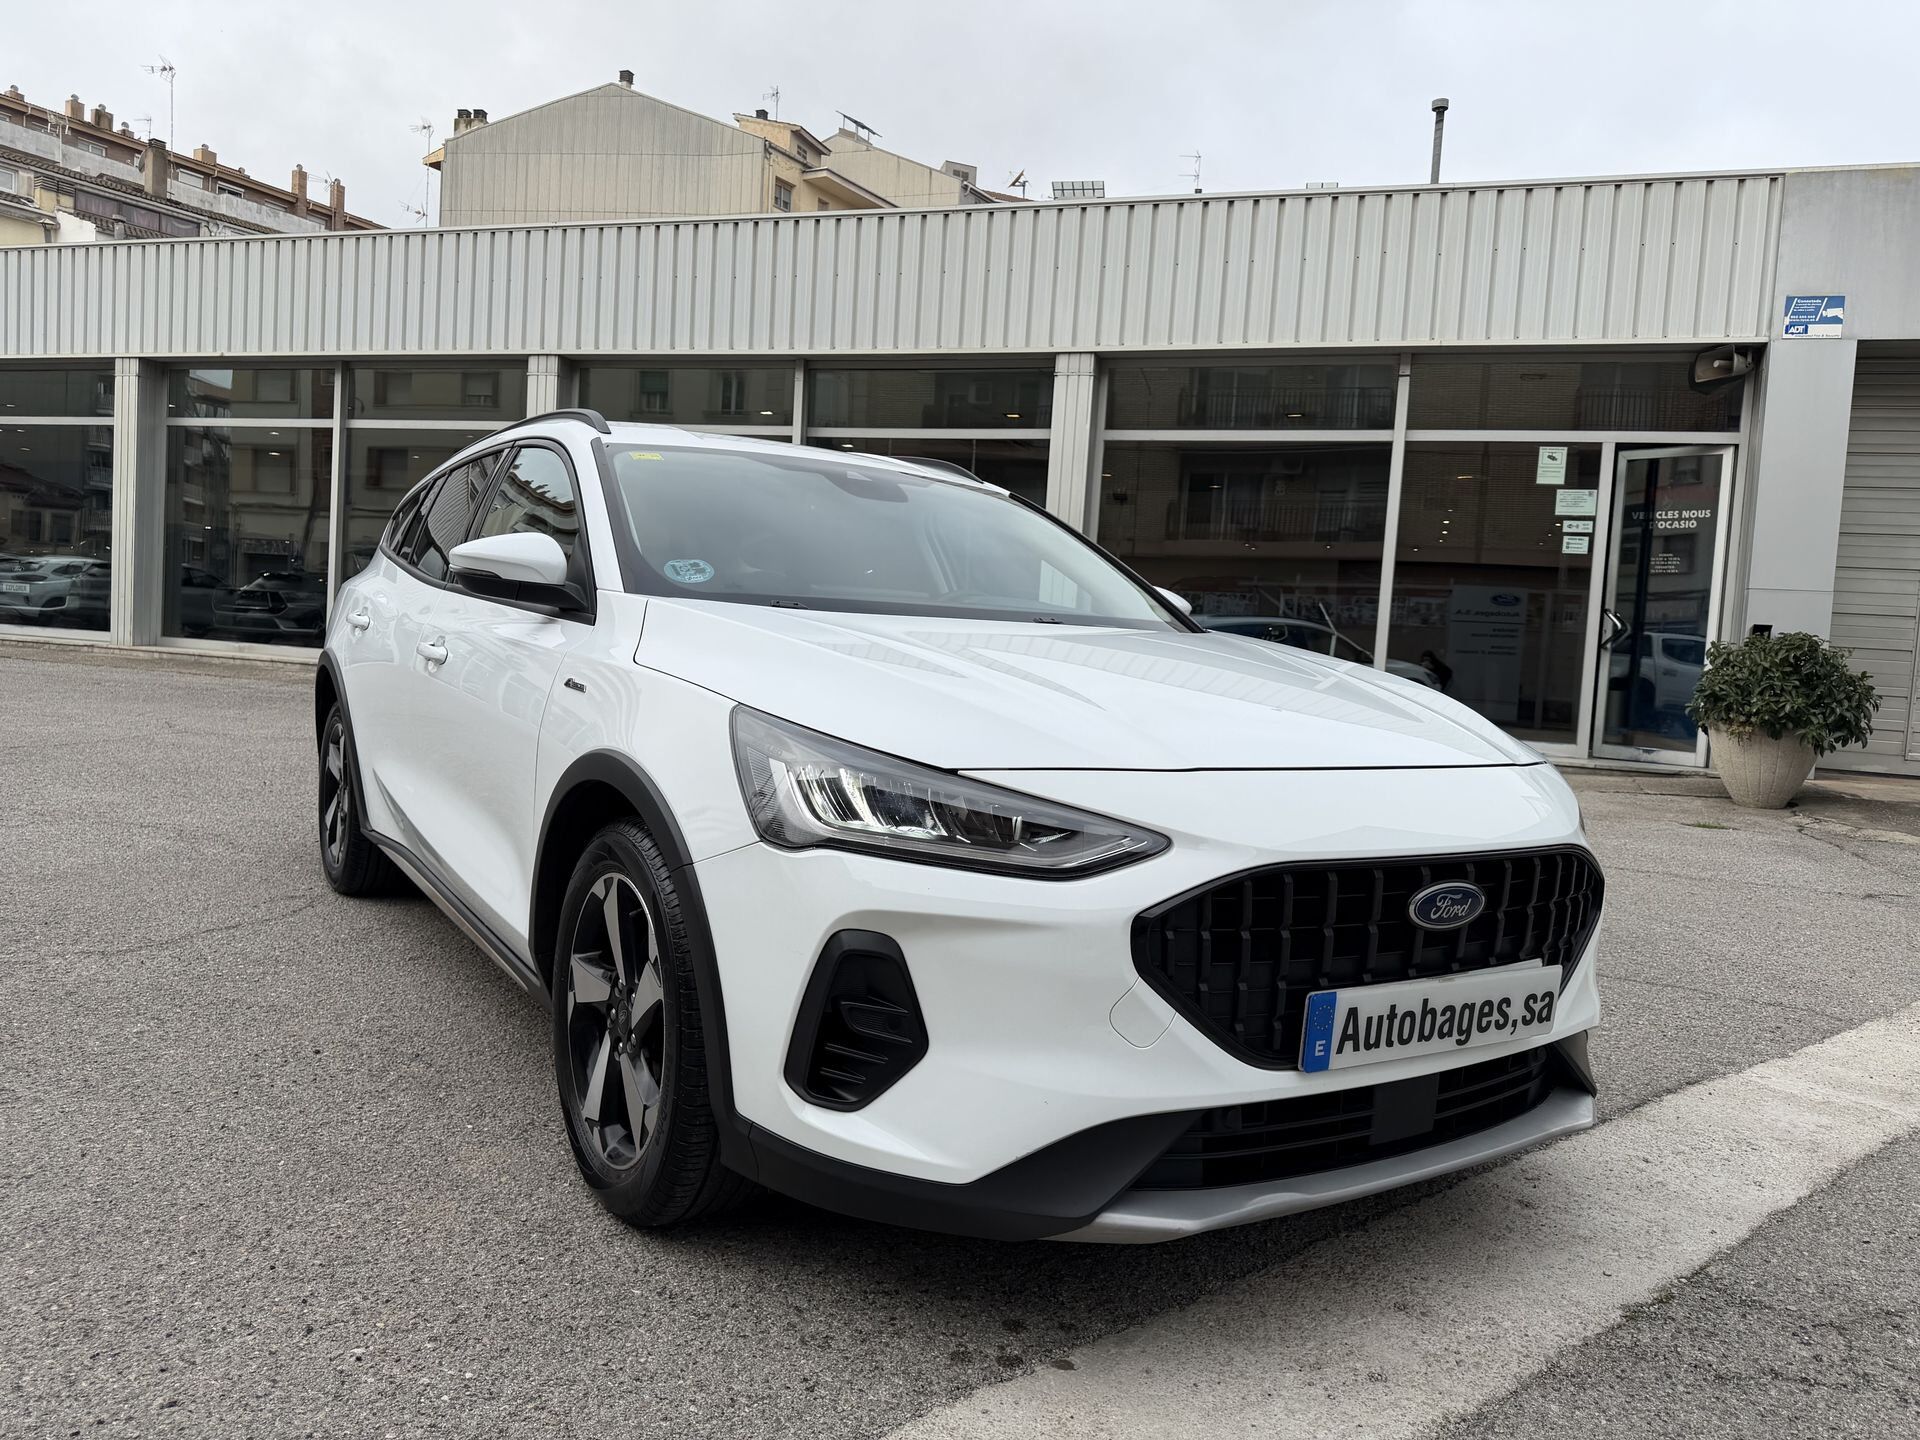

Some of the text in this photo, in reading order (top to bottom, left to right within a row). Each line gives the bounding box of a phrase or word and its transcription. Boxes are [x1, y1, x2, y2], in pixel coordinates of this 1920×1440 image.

[1788, 326, 1805, 334] ADT
[1681, 509, 1711, 520] NOUS
[1430, 892, 1471, 920] Ford
[1314, 990, 1555, 1057] E Autobages,sa
